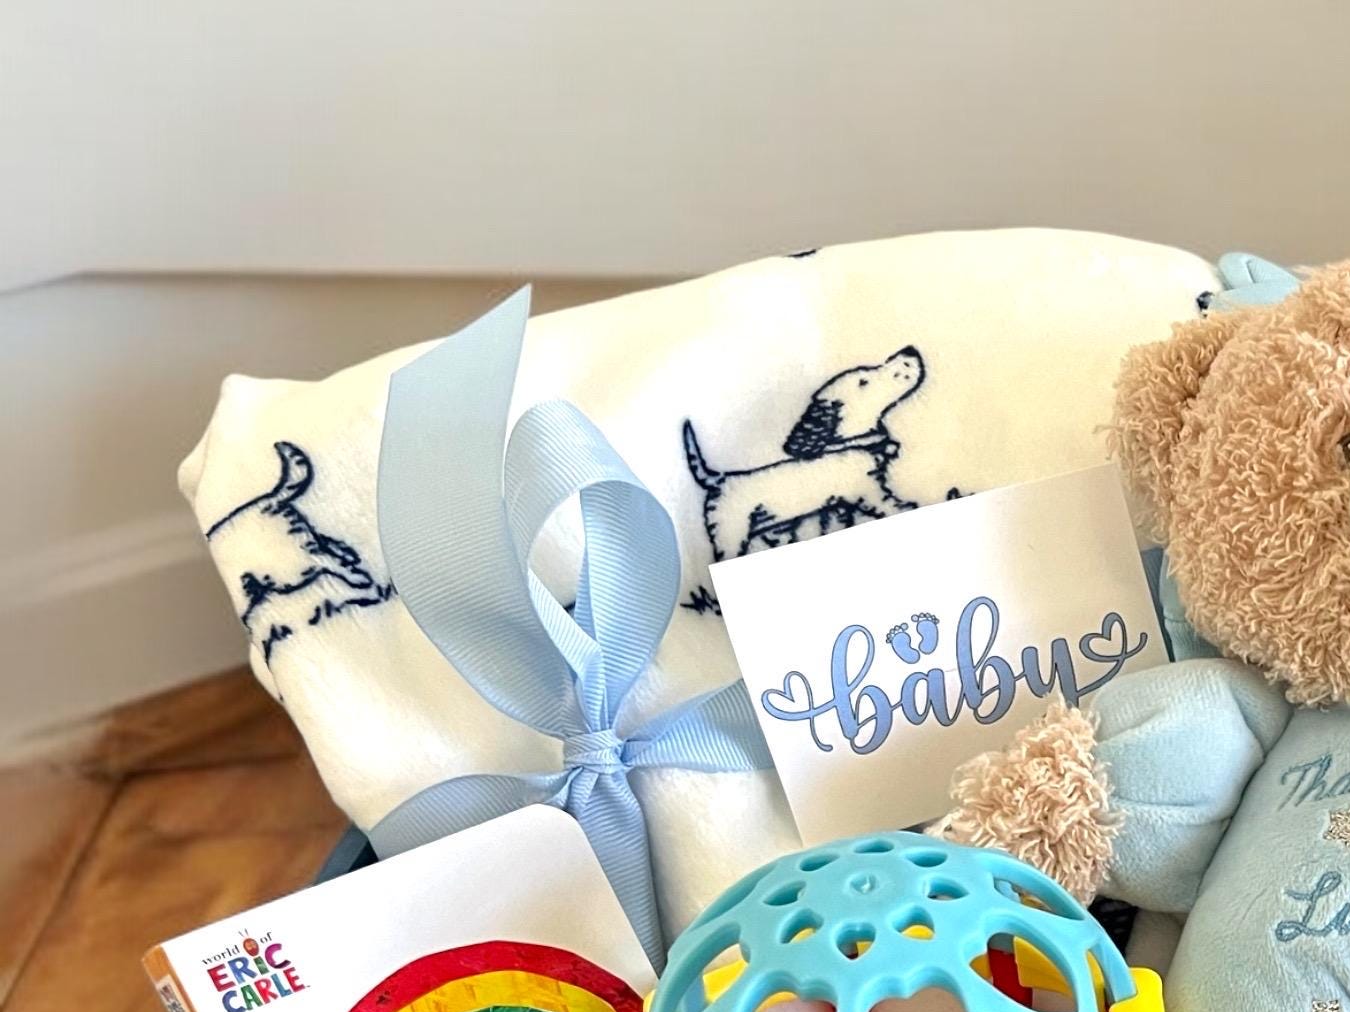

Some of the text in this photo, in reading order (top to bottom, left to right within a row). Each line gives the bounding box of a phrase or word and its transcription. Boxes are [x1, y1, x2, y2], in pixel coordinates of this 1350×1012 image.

[812, 596, 1123, 755] baby
[201, 931, 273, 966] world of
